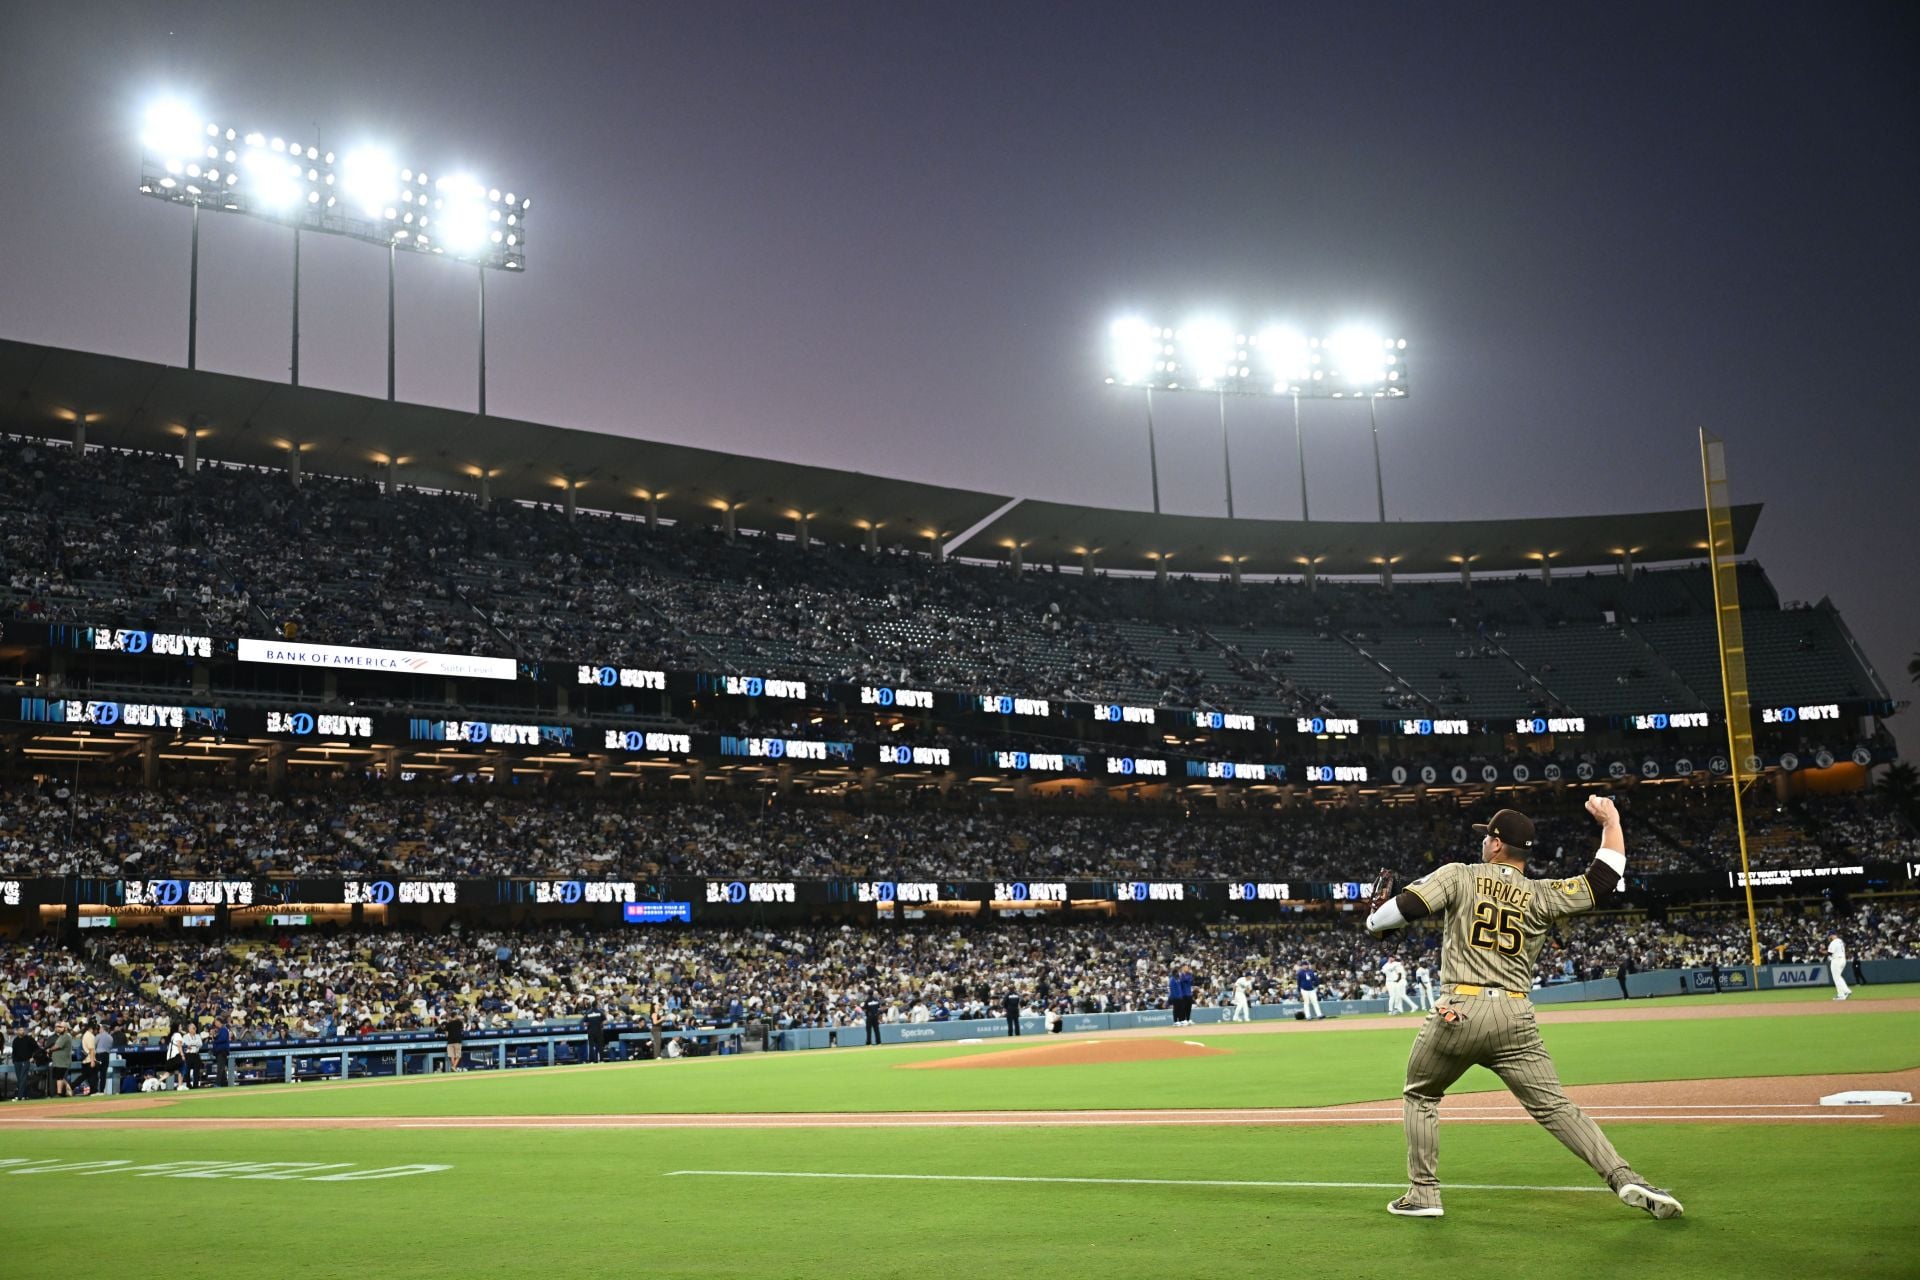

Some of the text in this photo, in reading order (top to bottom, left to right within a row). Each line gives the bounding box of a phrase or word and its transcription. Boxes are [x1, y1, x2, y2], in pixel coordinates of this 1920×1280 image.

[95, 628, 212, 657] BAD GUYS
[266, 649, 397, 668] BANK OF AMERICA
[620, 668, 665, 690] GUYS
[66, 700, 183, 728] BAD GUYS
[267, 711, 373, 737] BAD GUYS
[491, 724, 539, 746] GUYS
[646, 732, 690, 753] GUYS
[1484, 768, 1495, 779] 14
[1515, 767, 1526, 778] 19
[1547, 767, 1559, 778] 20
[1578, 766, 1593, 777] 24
[1610, 765, 1625, 776] 32
[1643, 764, 1658, 775] 34
[1676, 761, 1691, 772] 39
[1711, 759, 1726, 771] 42
[125, 880, 252, 905] BAD GUYS
[344, 880, 455, 904] BAD GUYS
[585, 882, 636, 904] GUYS
[750, 882, 795, 903] GUYS
[1476, 877, 1532, 908] FRANCE
[105, 905, 192, 915] ELYSIAN PARK GRILL
[281, 905, 302, 914] PARK
[304, 905, 326, 914] GRILL
[1470, 901, 1523, 956] 25
[1778, 971, 1807, 984] ANA
[901, 1027, 935, 1039] Spectrum
[79, 1160, 455, 1182] FIELD
